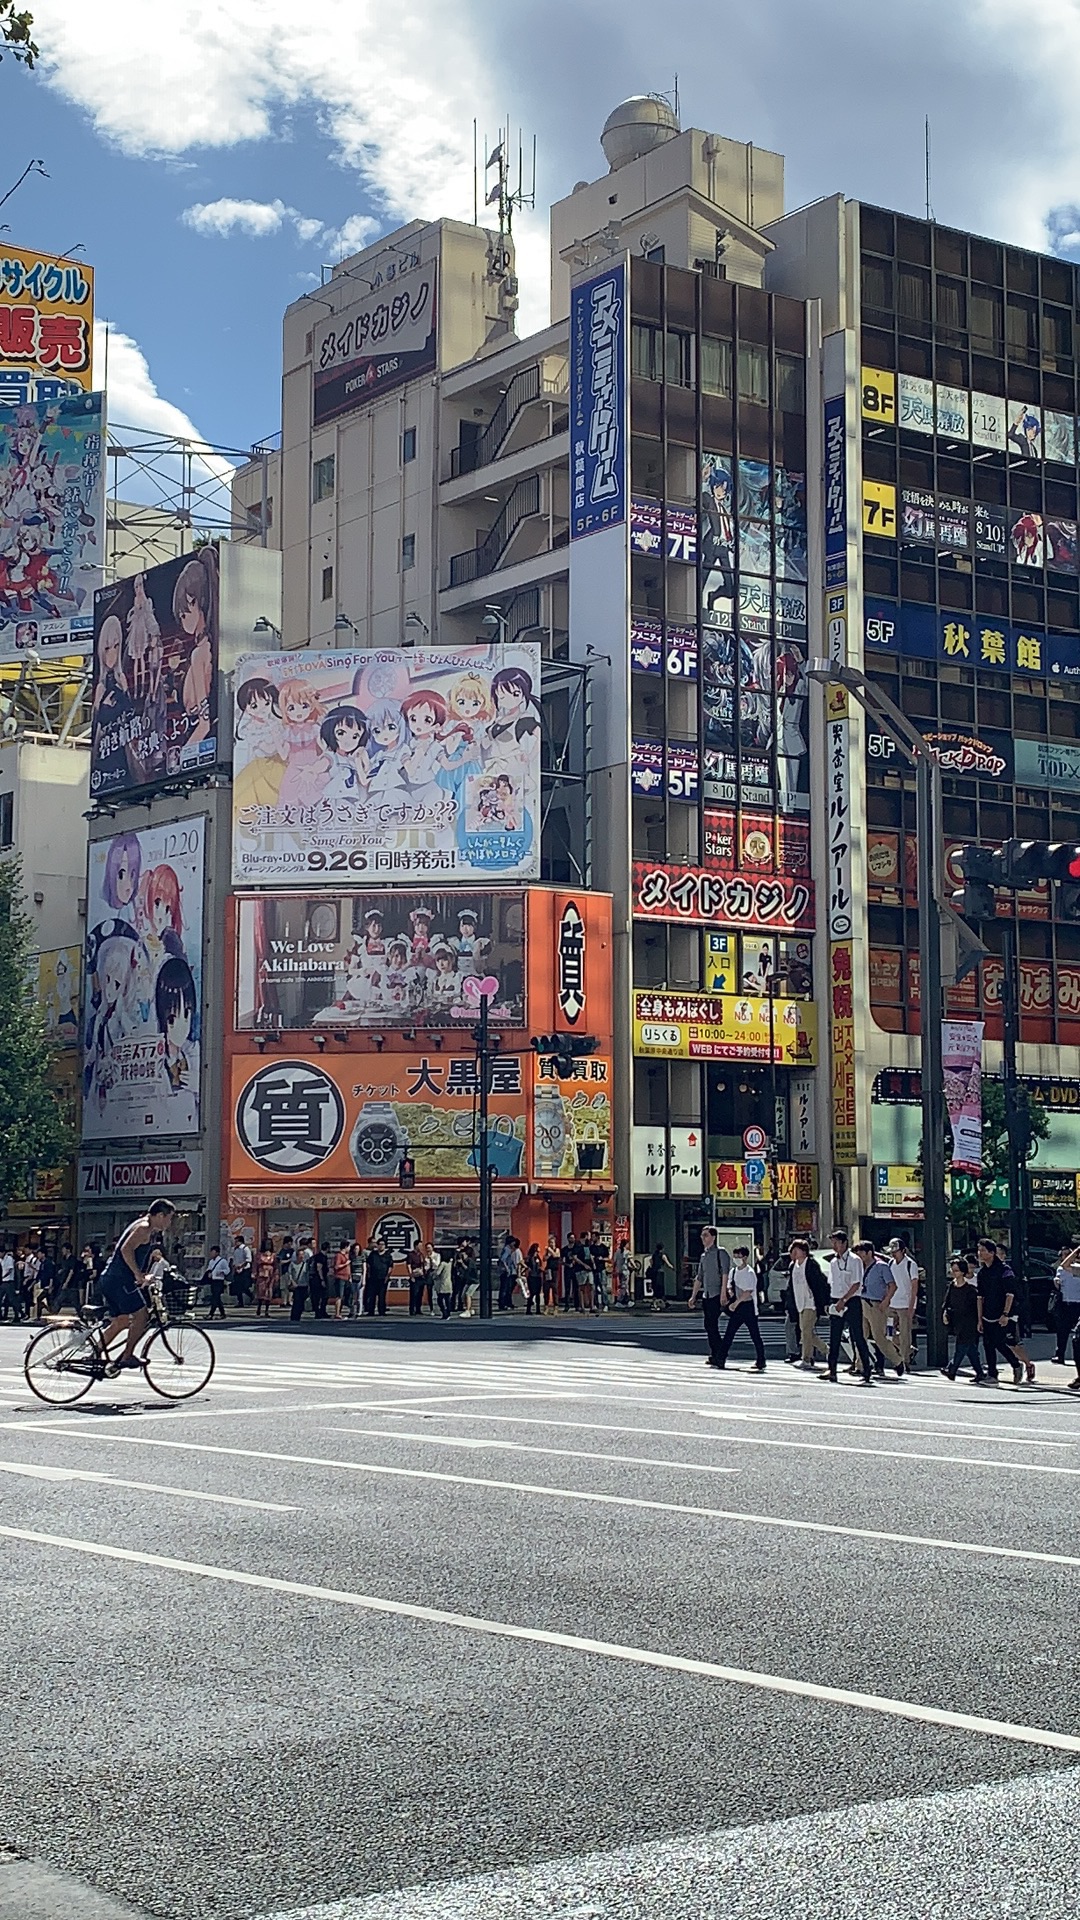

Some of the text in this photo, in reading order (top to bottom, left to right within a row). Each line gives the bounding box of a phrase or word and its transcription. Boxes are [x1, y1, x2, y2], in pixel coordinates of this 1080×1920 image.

[1, 260, 87, 302] サイクル
[0, 307, 82, 364] 販売
[320, 283, 428, 368] メイドカジノ
[345, 357, 399, 393] POKER STARS
[592, 281, 620, 503] アメニティードリーム
[863, 385, 894, 414] 8F
[982, 415, 997, 432] 12
[575, 441, 585, 508] 秋葉原店
[863, 499, 894, 528] 7F
[976, 521, 1000, 542] 8 10
[668, 533, 697, 560] 7F
[831, 597, 844, 611] 3F
[715, 612, 729, 627] 12
[741, 616, 767, 633] Stand
[867, 618, 894, 643] 5F
[833, 621, 841, 661] りらく
[943, 622, 1041, 671] 秋葉館
[327, 657, 352, 669] Sing
[353, 654, 371, 665] For
[374, 653, 394, 663] You
[667, 649, 697, 676] 6F
[868, 735, 895, 758] 5F
[668, 770, 698, 797] 5F
[713, 784, 719, 793] 8
[721, 785, 733, 798] 10
[742, 788, 770, 803] Stand
[238, 800, 458, 827] ご注文はうさぎですか??
[307, 850, 368, 871] 9.26
[375, 850, 456, 870] 同時発売!
[705, 843, 732, 857] Stars
[640, 870, 809, 924] メイドカジノ
[270, 941, 335, 953] We Love
[711, 938, 727, 950] 3F
[259, 958, 345, 972] Akihabara
[558, 918, 585, 1011] 質
[708, 956, 730, 969] 入口
[639, 998, 720, 1020] 全身もみほぐし
[759, 1013, 778, 1023] No1
[644, 1028, 678, 1042] りらくる
[844, 1025, 853, 1066] TAX
[692, 1044, 712, 1053] WEB
[407, 1058, 522, 1097] 大黒屋
[353, 1084, 399, 1098] チケット
[846, 1073, 856, 1126] FREE
[251, 1078, 332, 1160] 質
[799, 1094, 809, 1150] ルノアール
[749, 1133, 760, 1144] 40
[82, 1159, 171, 1195] ZIN COMIC ZIN
[645, 1164, 701, 1177] ルノアール
[749, 1165, 758, 1180] P
[788, 1165, 812, 1183] FREE
